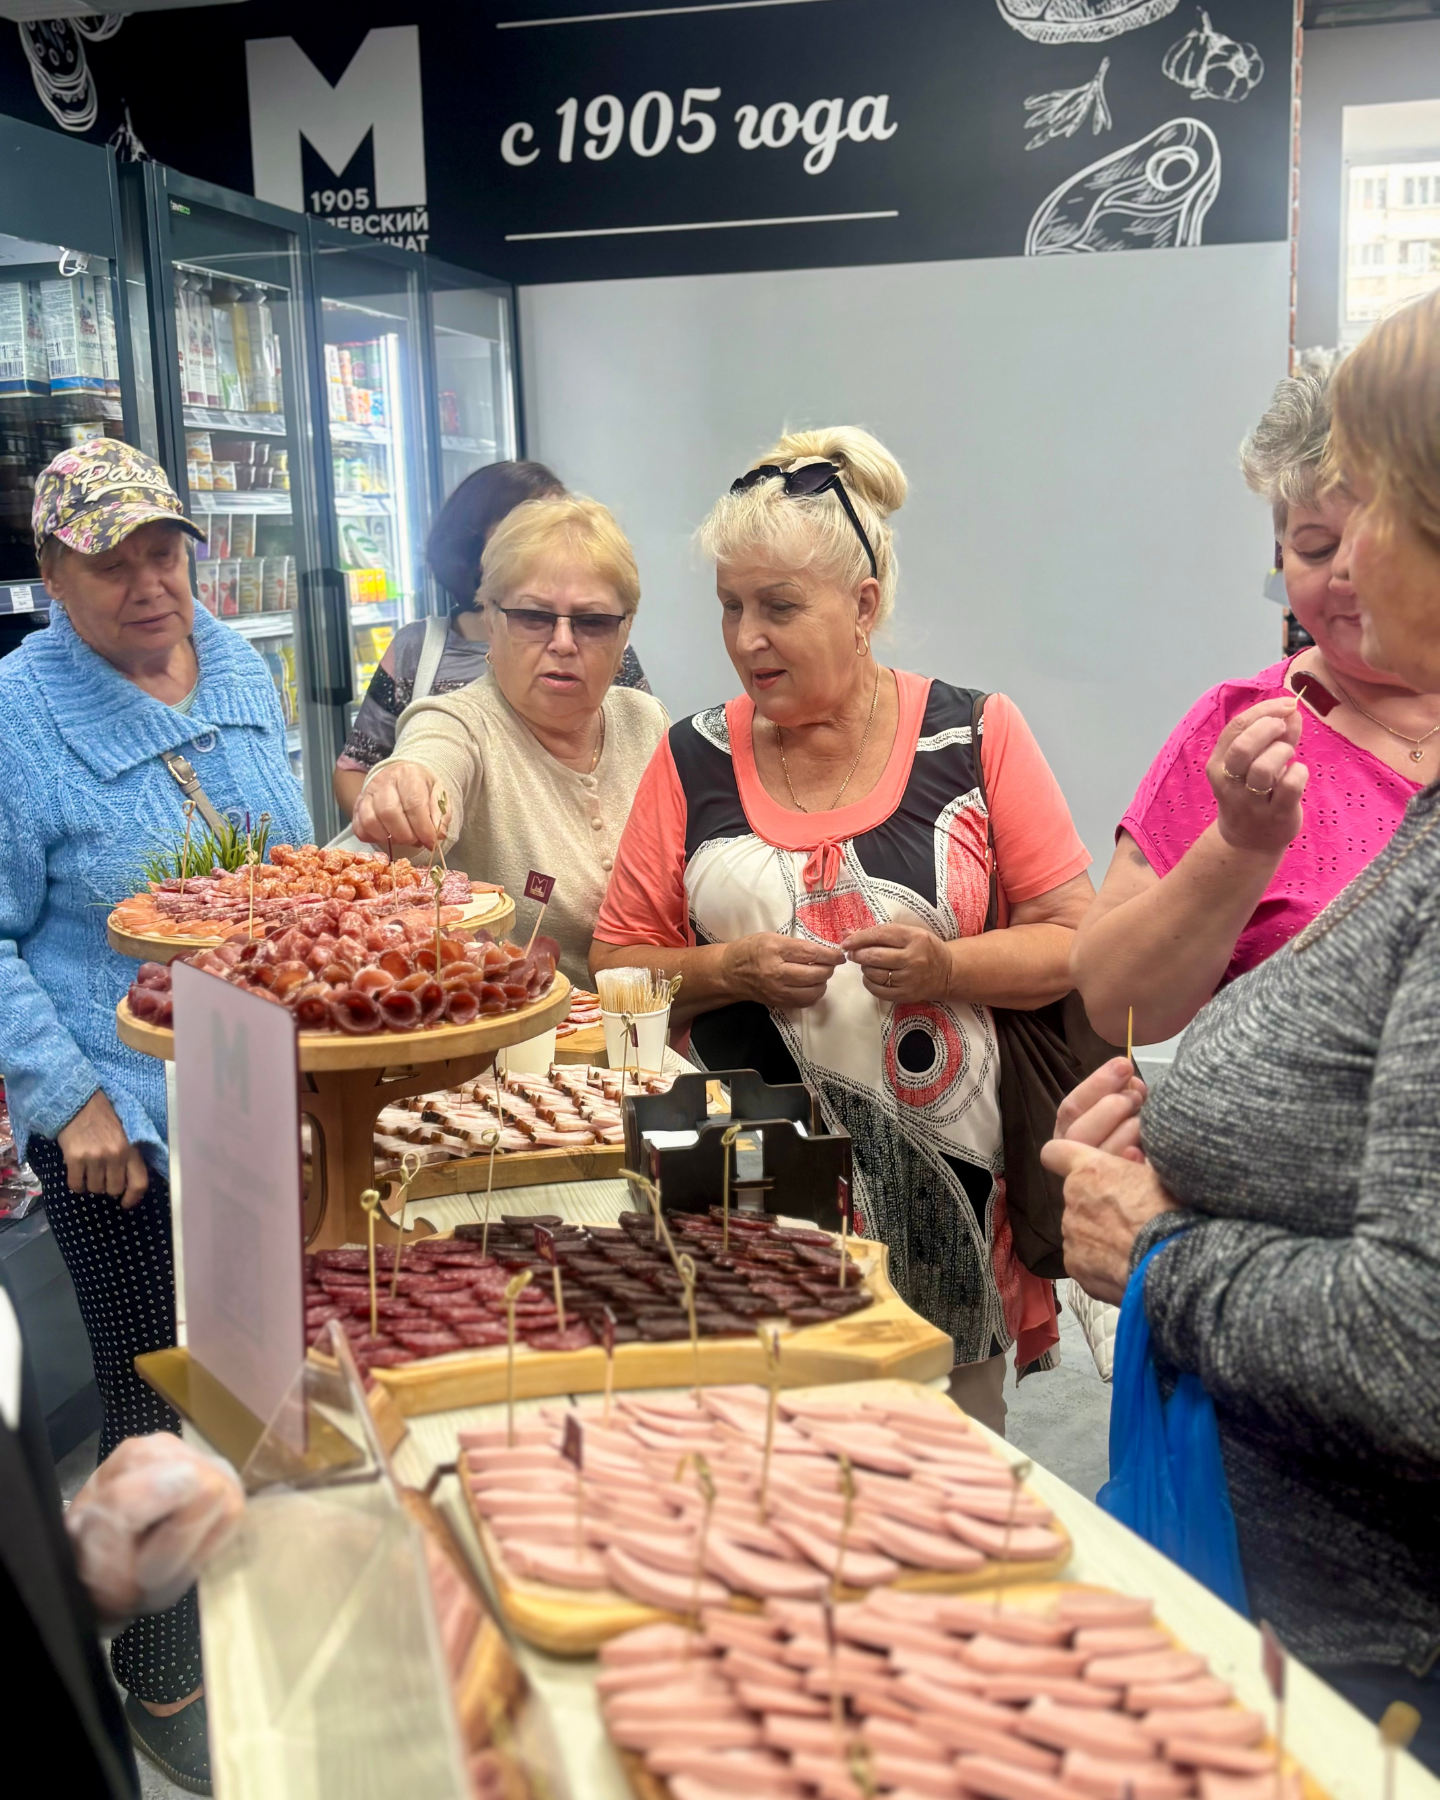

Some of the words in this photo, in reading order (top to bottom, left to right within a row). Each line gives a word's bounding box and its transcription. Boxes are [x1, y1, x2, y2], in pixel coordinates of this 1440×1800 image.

[245, 24, 427, 214] М
[500, 121, 541, 167] с
[556, 87, 722, 164] 1905
[734, 95, 899, 176] года
[310, 187, 370, 214] 1905
[76, 460, 168, 496] Paris
